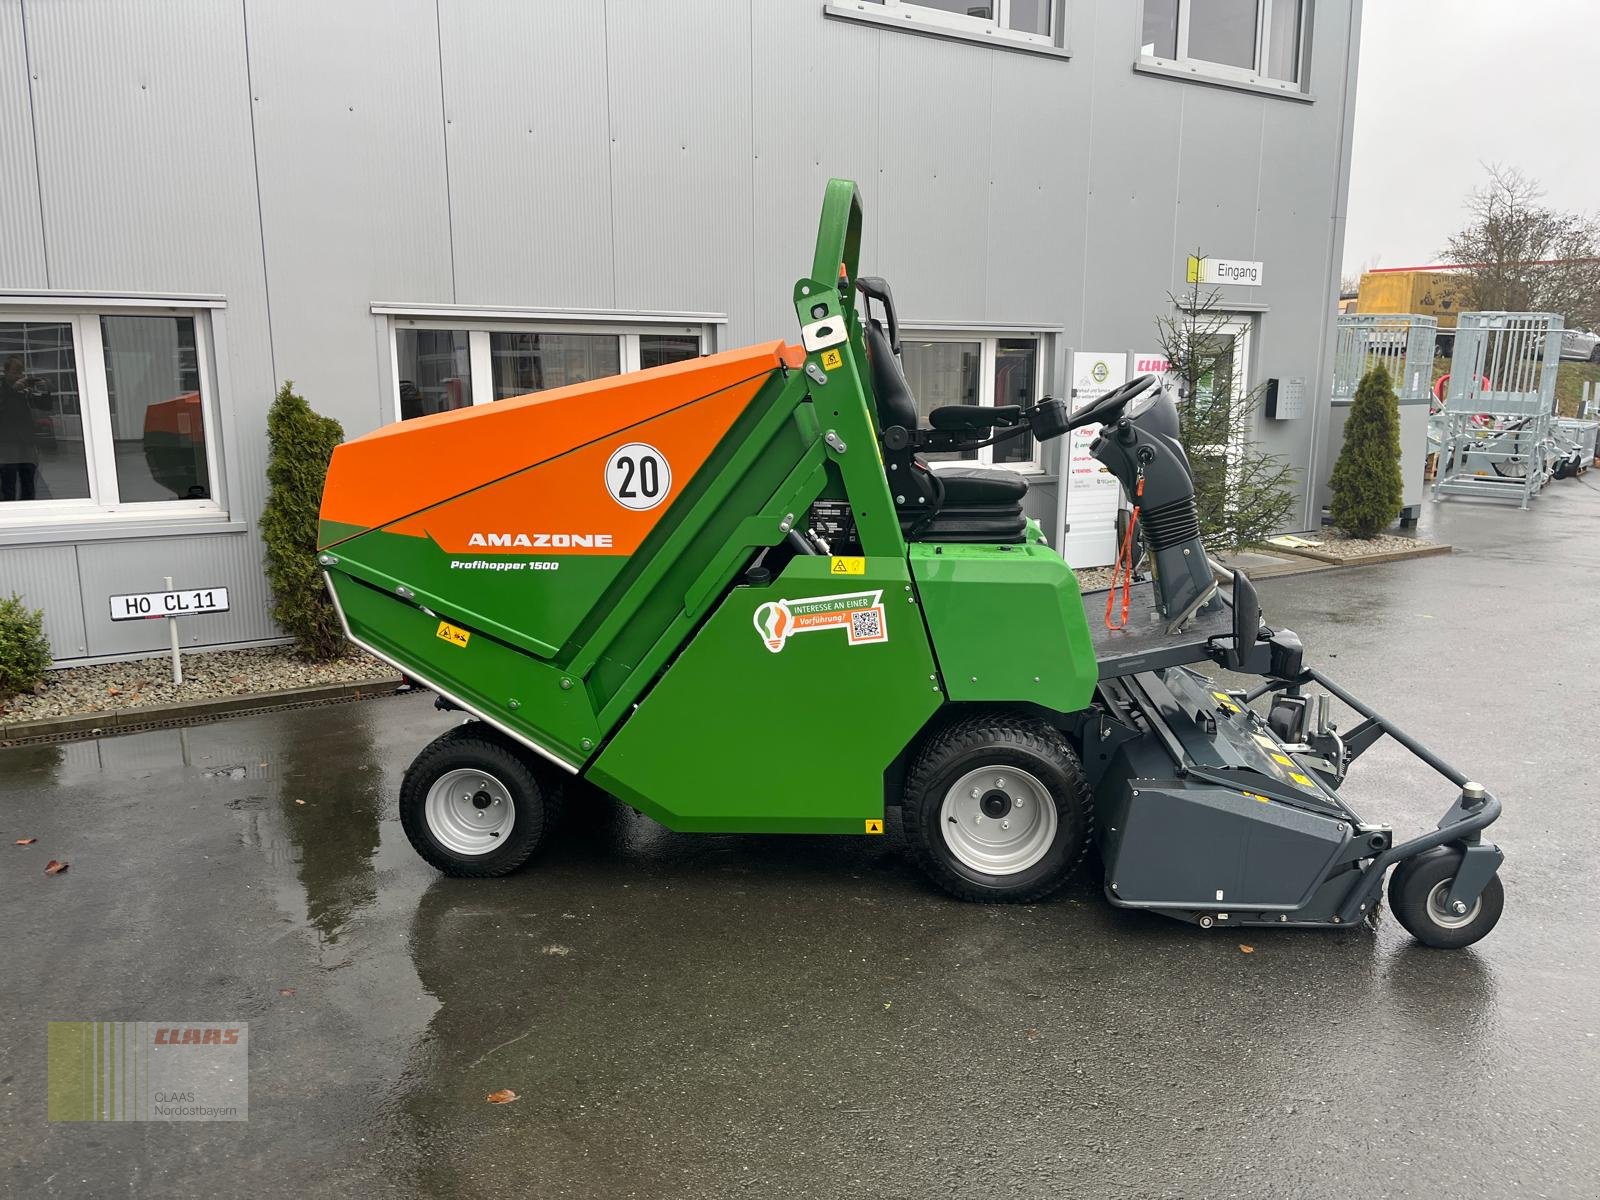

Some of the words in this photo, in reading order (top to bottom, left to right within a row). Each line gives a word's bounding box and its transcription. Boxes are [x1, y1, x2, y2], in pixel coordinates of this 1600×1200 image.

[1217, 263, 1257, 281] Eingang
[616, 455, 660, 498] 20
[467, 532, 613, 548] AMAZONE
[450, 560, 528, 572] Profihopper
[529, 561, 559, 571] 1500
[125, 596, 151, 615] HO
[164, 594, 189, 611] CL
[193, 591, 216, 609] 11
[794, 603, 832, 614] INTERESSE
[833, 601, 845, 609] AN
[847, 598, 869, 608] EINER
[799, 613, 847, 626] Vorführung?
